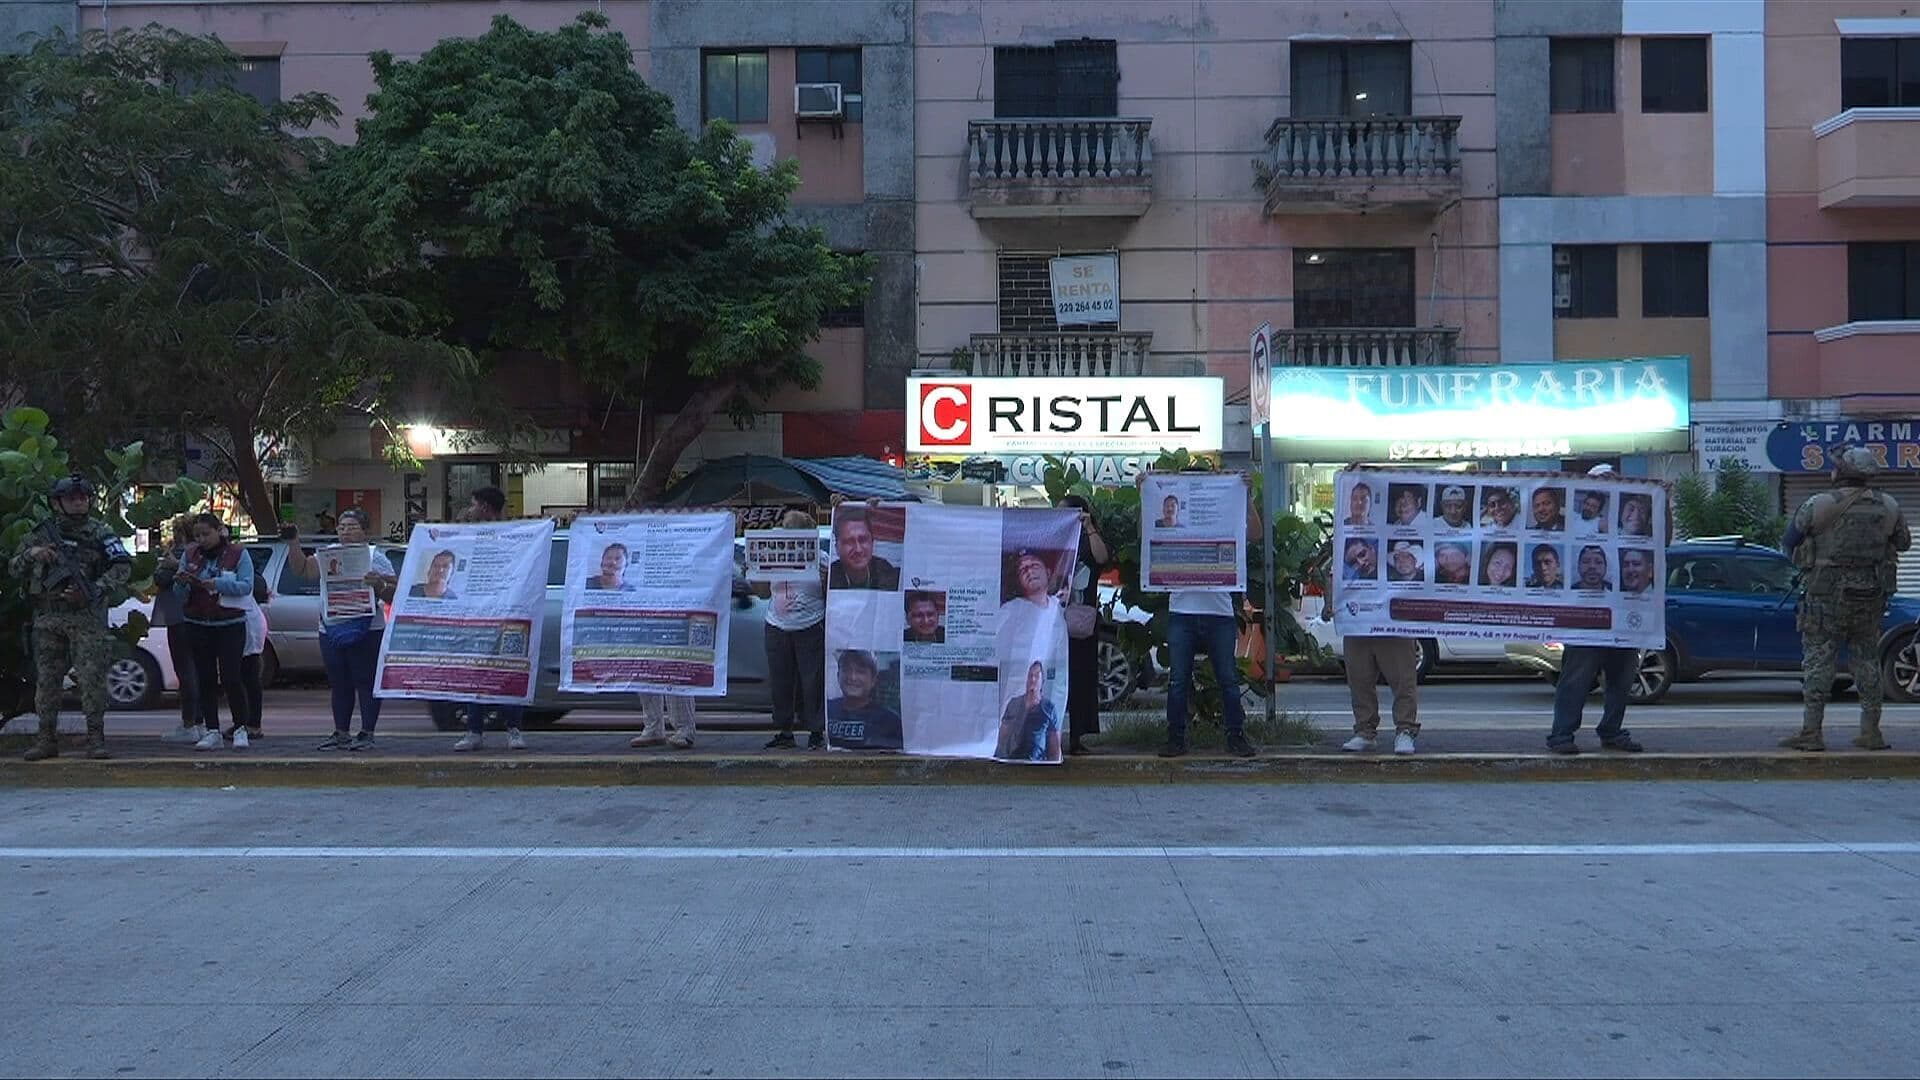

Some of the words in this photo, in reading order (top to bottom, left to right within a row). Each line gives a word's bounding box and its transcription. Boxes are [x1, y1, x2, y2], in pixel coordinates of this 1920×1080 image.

[1072, 265, 1094, 278] SE
[1057, 282, 1113, 297] RENTA
[1058, 303, 1073, 313] 229
[1075, 302, 1090, 313] 264
[1091, 301, 1102, 311] 45
[1103, 299, 1113, 310] 02
[1346, 365, 1669, 409] FUNERARIA
[1704, 425, 1768, 433] MEDICAMENTOS
[1825, 423, 1920, 442] FARM
[1746, 436, 1757, 444] DE
[1706, 458, 1715, 469] Y
[1801, 443, 1920, 470] SRR
